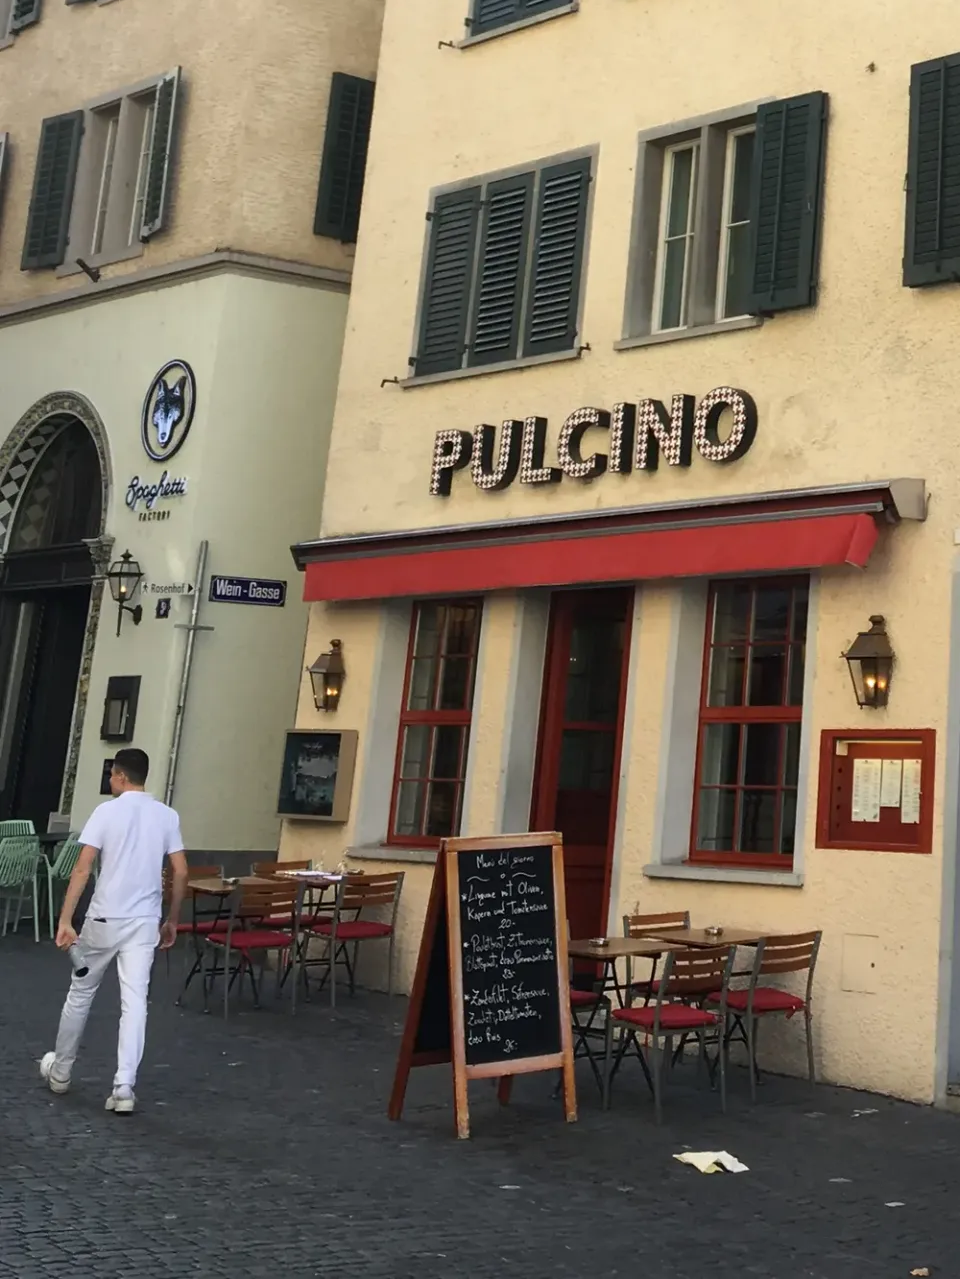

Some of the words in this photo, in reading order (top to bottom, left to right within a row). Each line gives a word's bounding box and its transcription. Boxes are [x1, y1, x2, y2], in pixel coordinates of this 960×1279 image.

[430, 386, 758, 496] PULCINO
[126, 470, 188, 511] Spaghetti
[138, 510, 171, 521] FACTORY
[151, 583, 185, 594] Rosenhof
[497, 851, 510, 865] del
